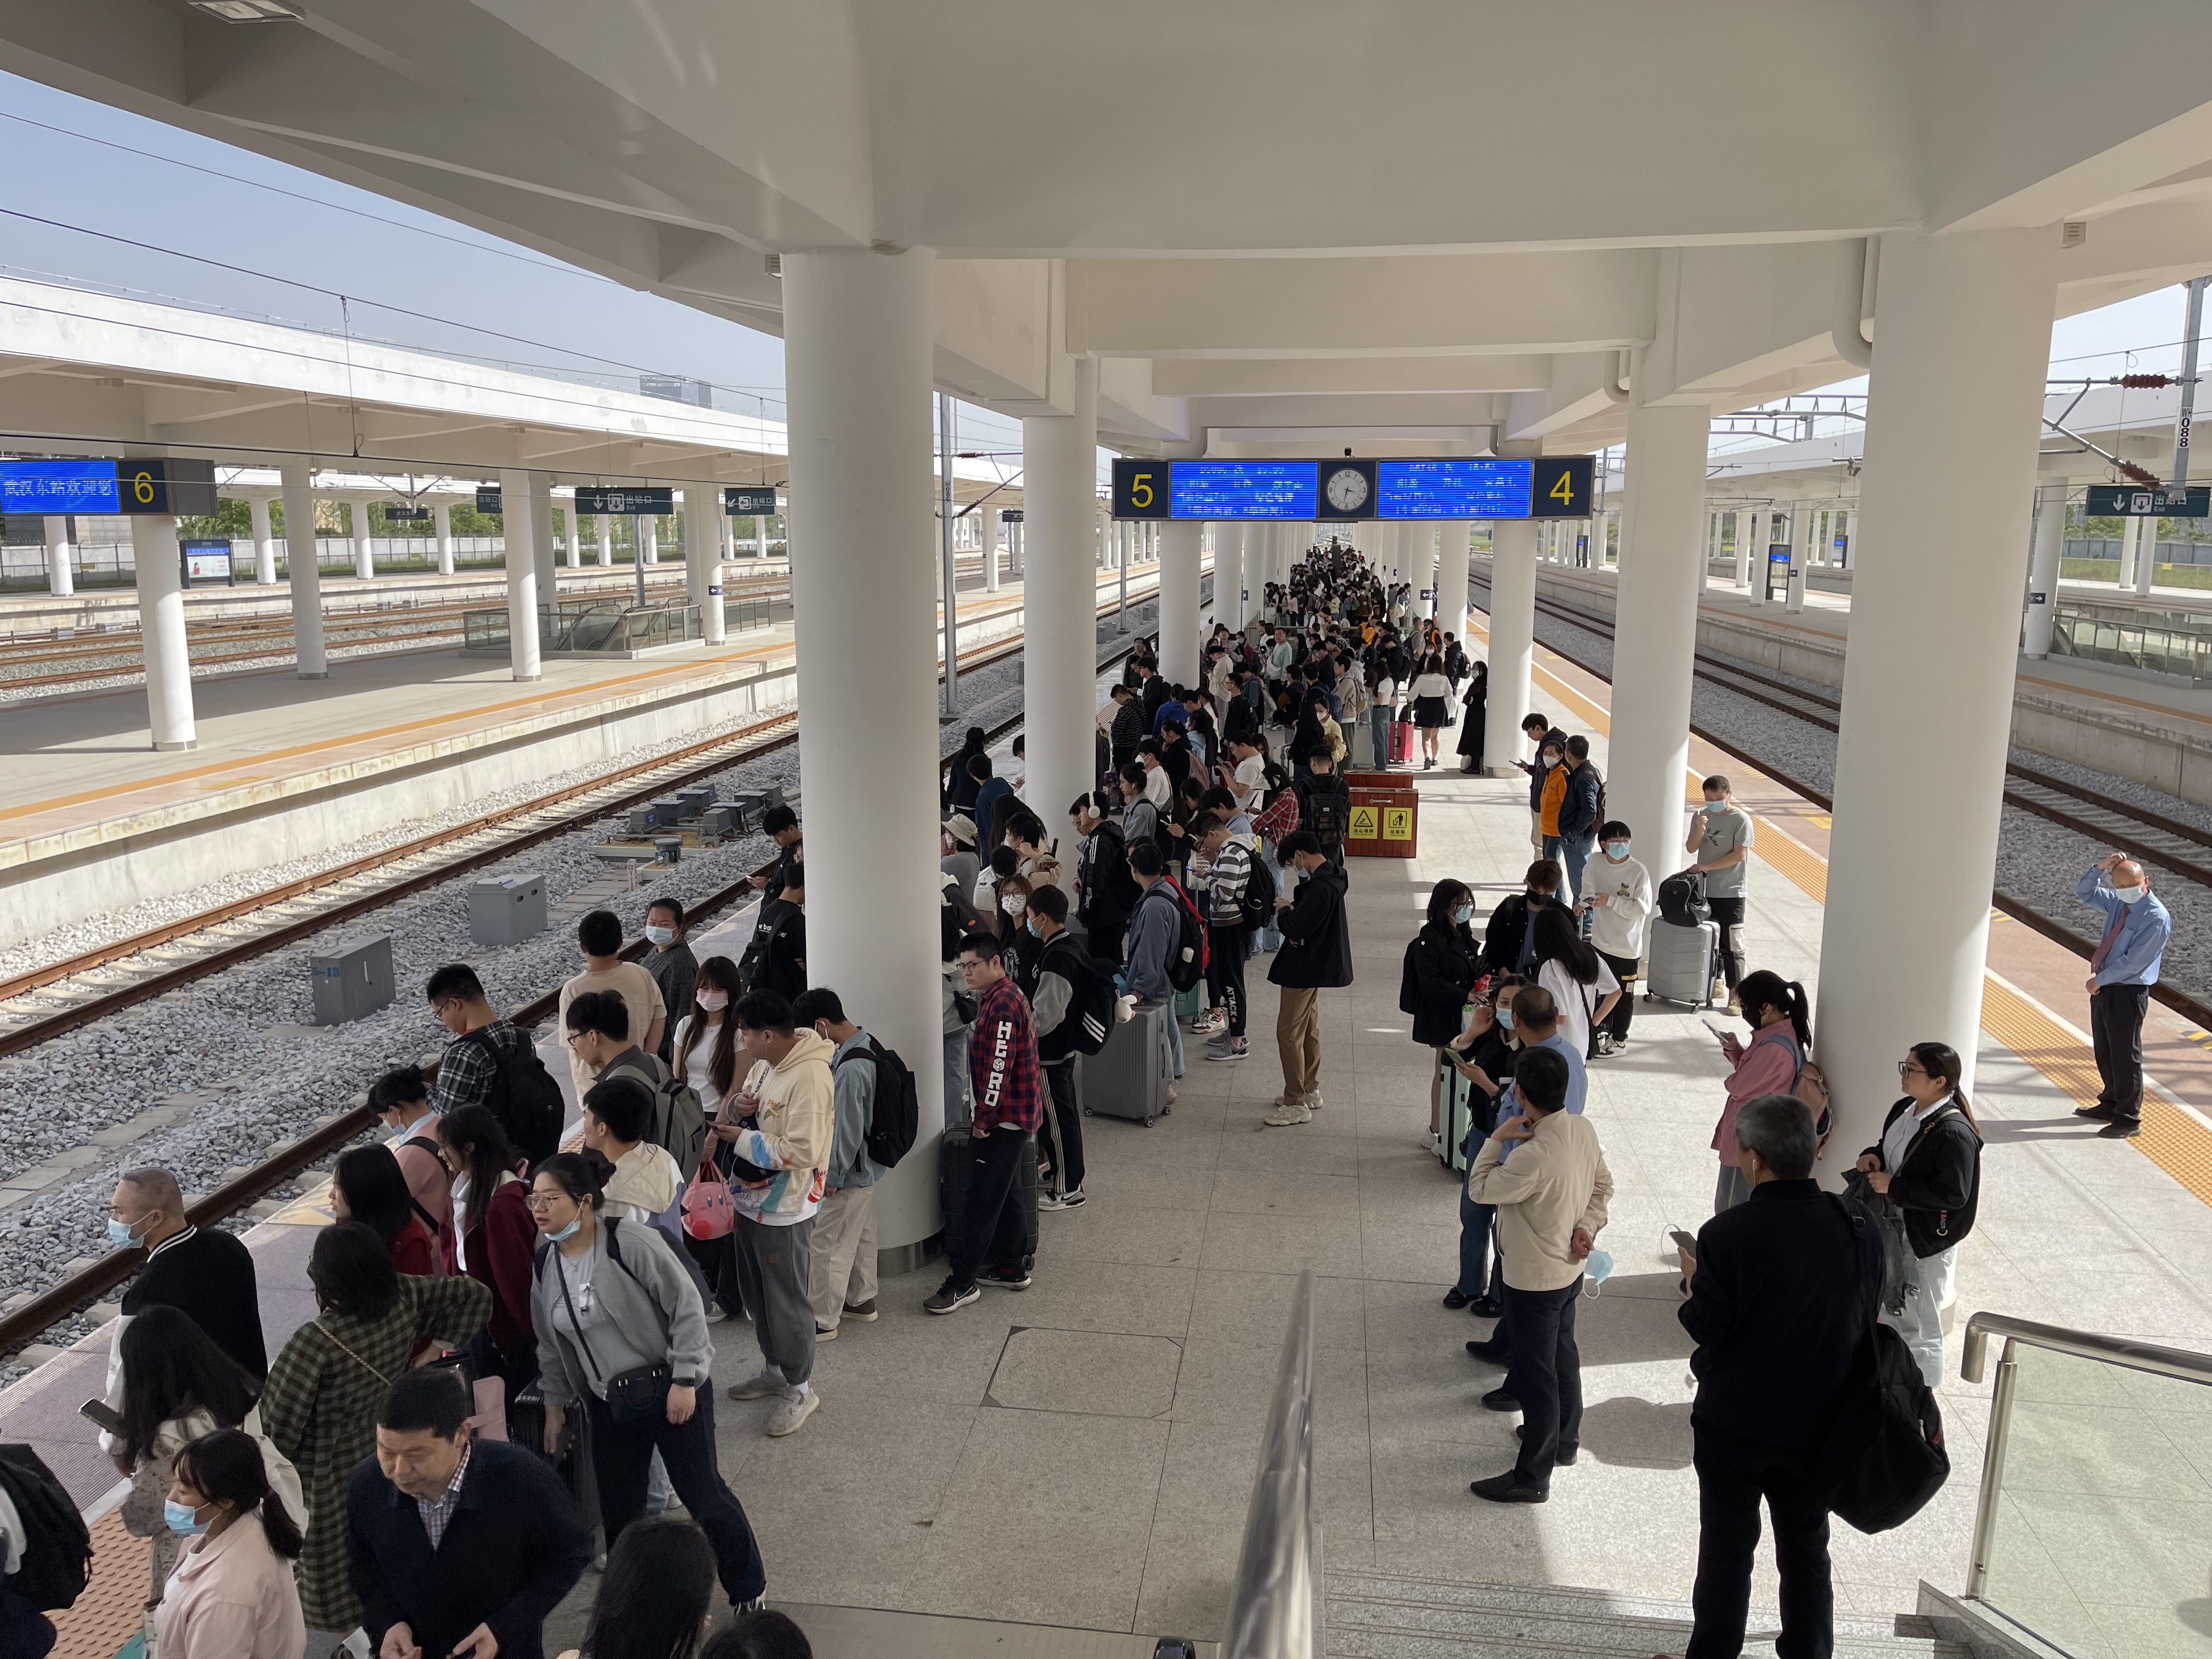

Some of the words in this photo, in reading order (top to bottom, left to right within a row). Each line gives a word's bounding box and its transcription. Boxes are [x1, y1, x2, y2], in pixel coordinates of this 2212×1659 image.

[2182, 408, 2192, 417] WH
[2180, 417, 2190, 447] 088
[134, 471, 154, 503] 6
[626, 495, 652, 504] 出站口
[1131, 474, 1153, 507] 5
[1549, 471, 1574, 505] 4
[1226, 986, 1237, 1017] ATTACK
